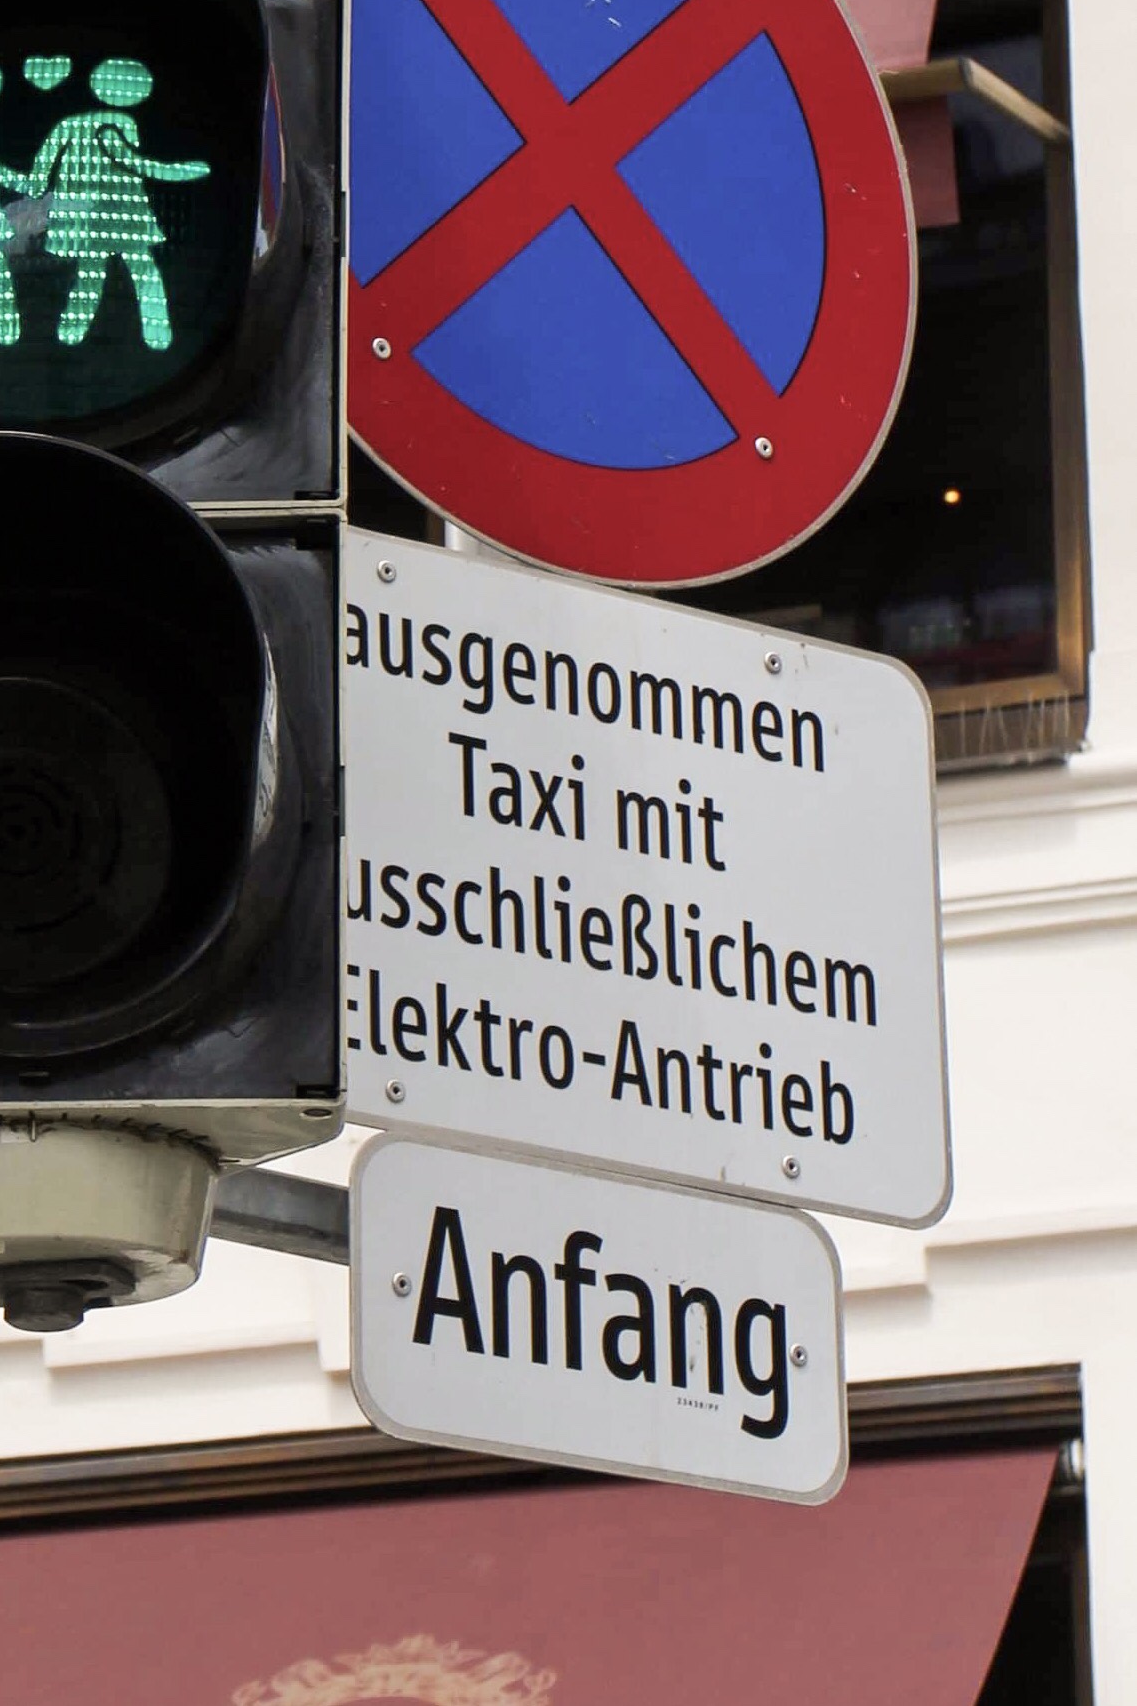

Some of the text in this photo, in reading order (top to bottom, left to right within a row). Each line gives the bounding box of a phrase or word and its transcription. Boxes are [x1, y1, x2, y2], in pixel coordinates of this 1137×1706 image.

[347, 602, 824, 772] ausgenommen
[448, 732, 726, 872] Taxi mit
[412, 1206, 790, 1440] Anfang
